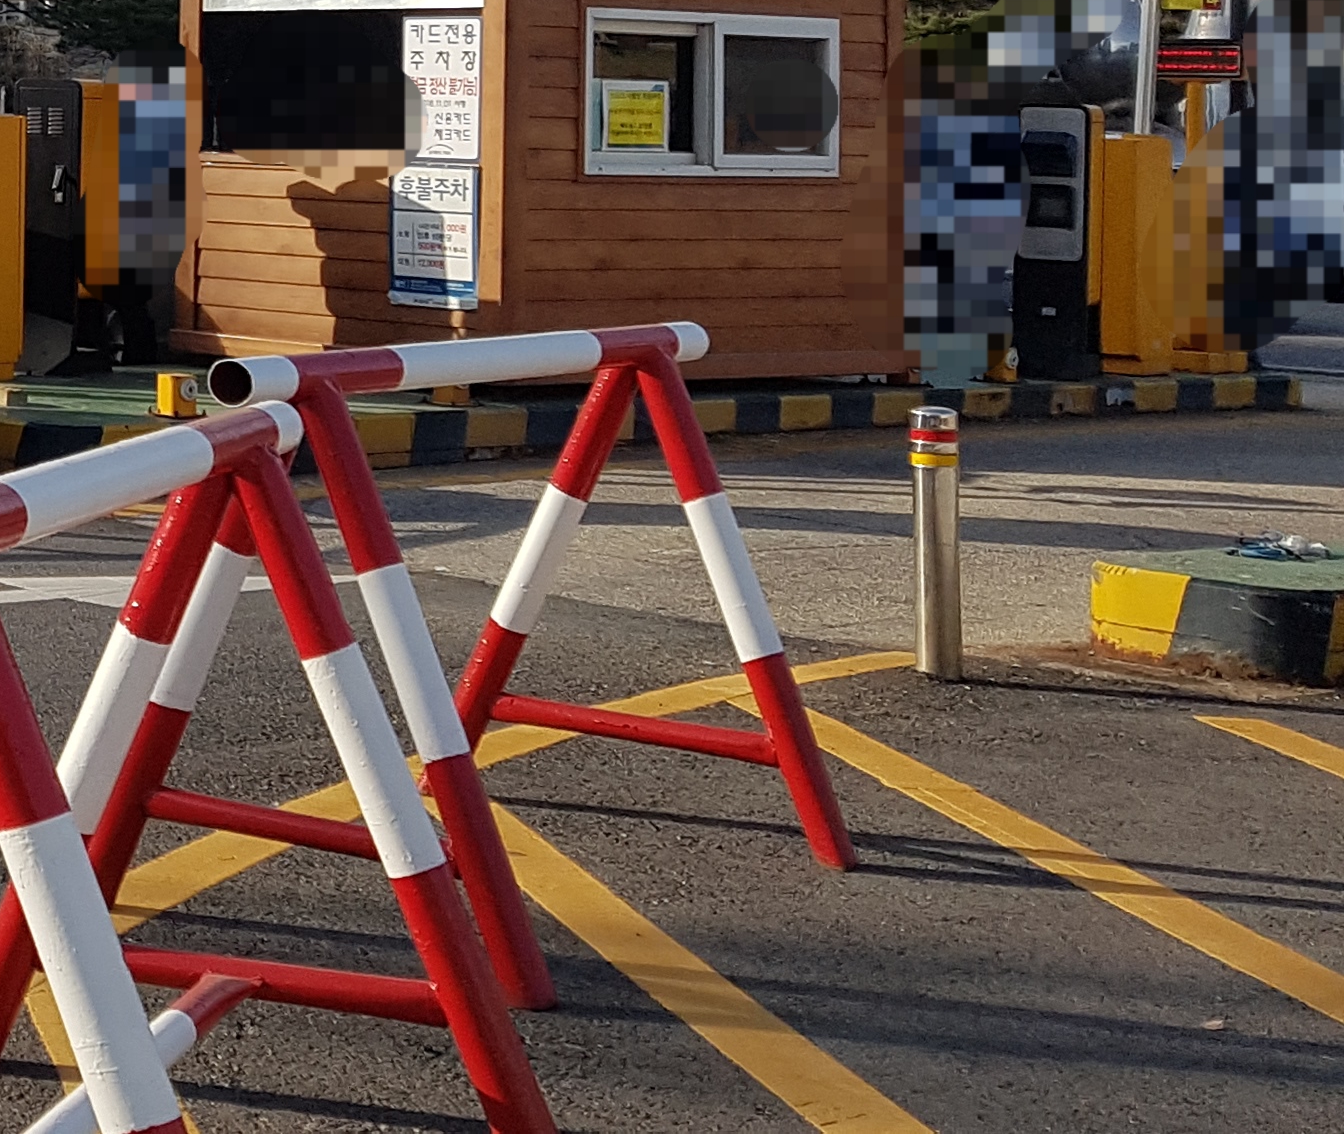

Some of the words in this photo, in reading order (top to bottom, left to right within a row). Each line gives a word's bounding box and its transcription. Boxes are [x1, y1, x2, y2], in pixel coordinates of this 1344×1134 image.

[410, 24, 477, 44] 카드전용
[429, 77, 447, 95] 정산
[434, 112, 471, 125] 신용카드
[434, 128, 471, 141] 체크카드
[398, 176, 469, 202] 후불주차
